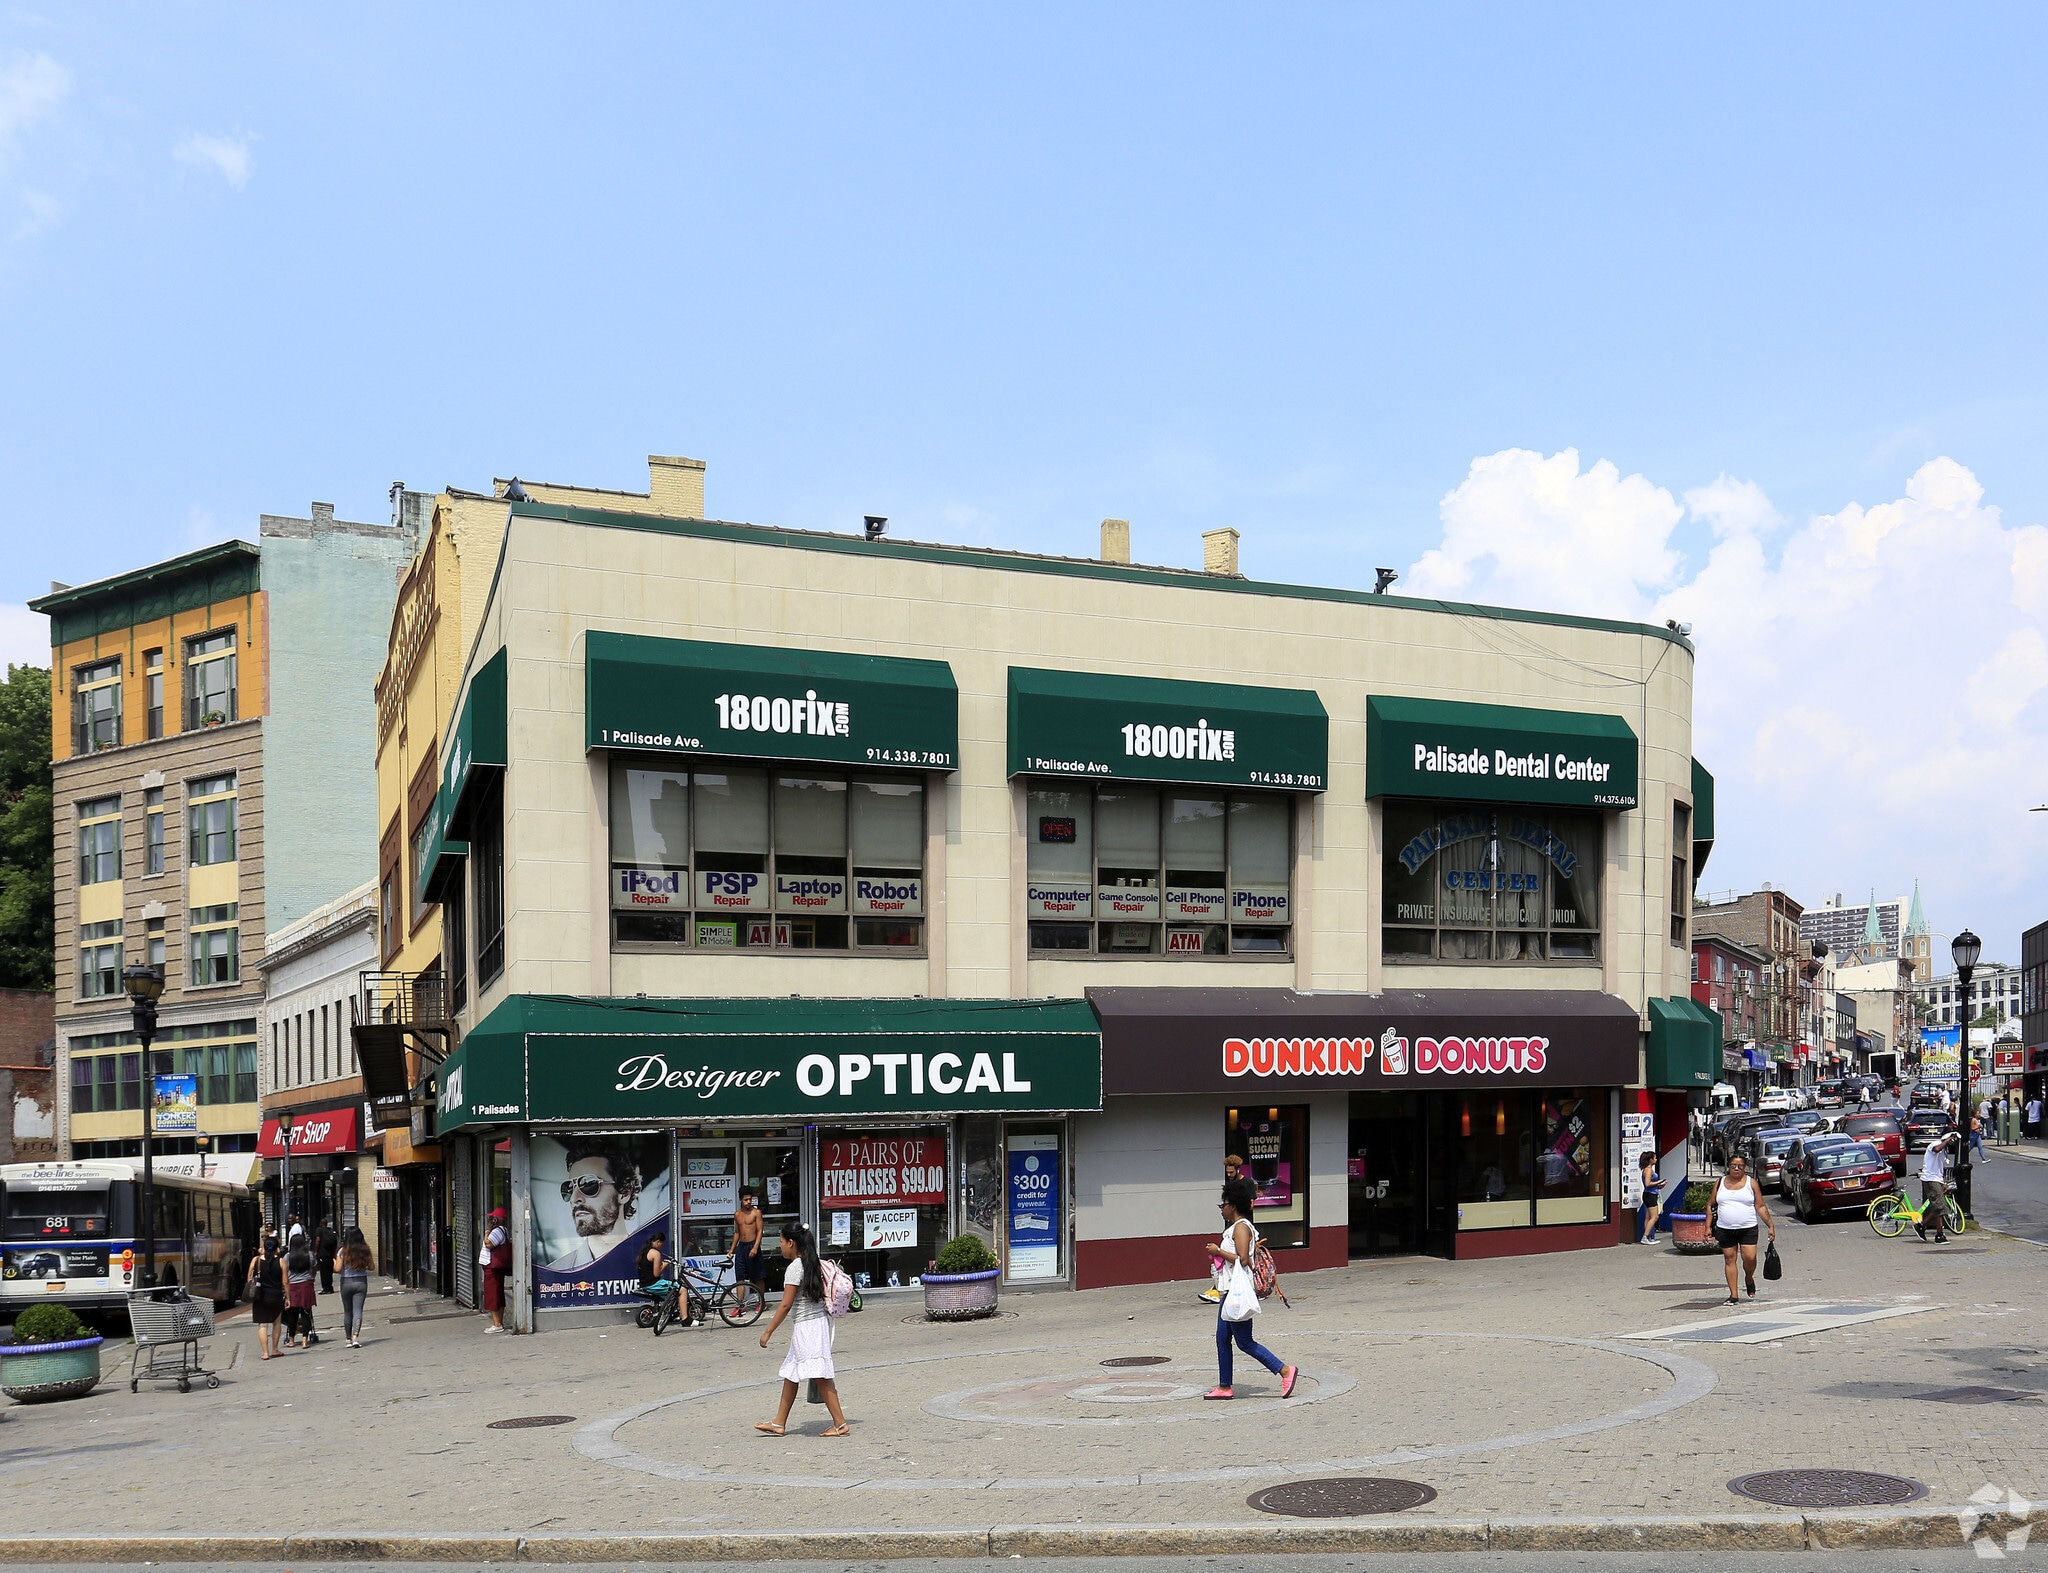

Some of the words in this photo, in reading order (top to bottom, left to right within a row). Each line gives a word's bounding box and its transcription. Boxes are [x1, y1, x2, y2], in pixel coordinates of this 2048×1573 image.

[601, 730, 608, 742] 1
[612, 730, 672, 747] Palisade
[674, 734, 704, 749] Ave.
[866, 748, 951, 765] 914.338.7801
[1414, 743, 1490, 775] Palisade
[1494, 749, 1549, 779] Dental
[1554, 753, 1610, 783] Center
[1026, 757, 1032, 768] 1
[1036, 757, 1085, 772] Palisade
[1087, 761, 1112, 773] Ave.
[1250, 771, 1322, 786] 914.338.7801
[1594, 794, 1635, 805] 914.375.6106
[1042, 823, 1072, 836] OPEN
[621, 870, 679, 894] iPod
[706, 872, 758, 895] PSP
[777, 877, 843, 899] Laptop
[1446, 870, 1539, 893] CENTER
[857, 880, 918, 901] Robot
[1028, 888, 1091, 903] Computer
[1098, 892, 1124, 902] Game
[1125, 893, 1159, 902] Console
[631, 893, 670, 906] Repair
[713, 895, 751, 907] Repair
[792, 895, 829, 908] Repair
[1165, 891, 1187, 902] Cell
[1190, 892, 1224, 904] Phone
[1232, 891, 1287, 908] iPhone
[870, 899, 905, 912] Repair
[1043, 901, 1076, 912] Repair
[1113, 901, 1145, 913] Repair
[1180, 903, 1211, 914] Repair
[1245, 907, 1274, 918] Repair
[1397, 904, 1434, 920] PRIVATE
[1440, 905, 1491, 922] INSURANCE
[1497, 907, 1538, 923] MEDICAID
[700, 927, 732, 936] SIMPLE
[749, 926, 788, 943] ATM
[708, 936, 732, 945] Mobile
[1169, 933, 1201, 950] ATM
[1223, 1038, 1374, 1077] DUNKIN'
[1415, 1036, 1547, 1075] DONUTS
[2005, 1053, 2013, 1063] P
[1922, 1062, 1960, 1071] YONKERS
[615, 1053, 781, 1098] Designer
[795, 1052, 1032, 1097] OPTICAL
[471, 1105, 476, 1115] 1
[478, 1103, 520, 1115] Palisades
[156, 1112, 197, 1120] YONKERS
[302, 1120, 331, 1145] SHOP
[1642, 1116, 1652, 1136] 2
[1249, 1135, 1280, 1145] BROWN
[832, 1143, 842, 1167] 2
[850, 1141, 899, 1166] PAIRS
[903, 1140, 925, 1164] OF
[1249, 1144, 1280, 1154] SUGAR
[688, 1161, 711, 1171] GVS
[33, 1169, 74, 1179] bee-line
[684, 1180, 697, 1189] WE
[698, 1179, 731, 1189] ACCEPT
[824, 1168, 897, 1197] EYEGLASSES
[901, 1165, 944, 1196] $99.00
[1013, 1174, 1050, 1190] $300
[1016, 1191, 1036, 1199] credit
[690, 1198, 708, 1206] Affinity
[1017, 1200, 1047, 1209] eyewear.
[46, 1217, 68, 1227] 681
[866, 1214, 879, 1223] WE
[881, 1212, 915, 1222] ACCEPT
[86, 1219, 95, 1230] 6
[884, 1230, 910, 1242] MVP
[698, 1259, 720, 1267] WellC
[597, 1279, 640, 1296] EYEWE
[540, 1291, 595, 1299] RACING
